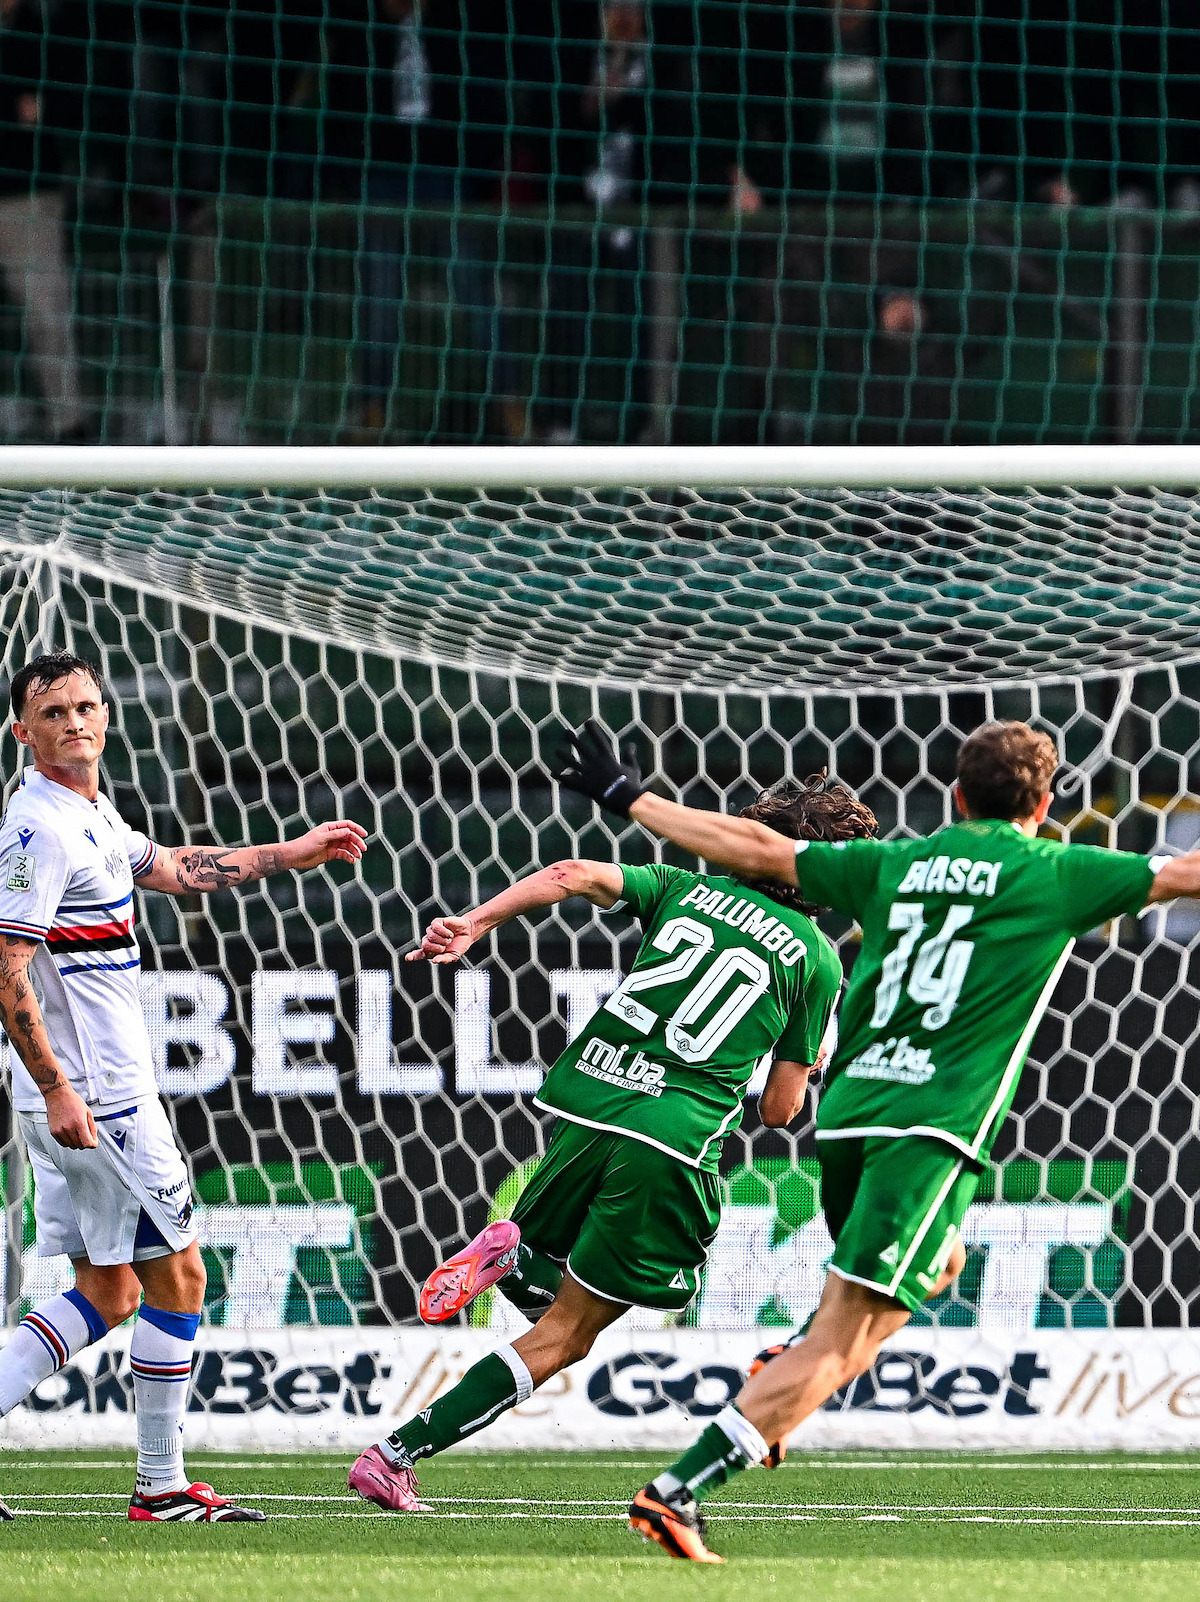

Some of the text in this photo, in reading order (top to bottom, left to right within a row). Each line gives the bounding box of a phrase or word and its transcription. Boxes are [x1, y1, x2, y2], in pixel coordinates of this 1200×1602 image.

[897, 856, 1002, 897] BIASCI
[678, 882, 807, 968] PALUMBO
[868, 902, 976, 1031] 14
[602, 916, 771, 1063] 20
[138, 969, 642, 1097] BELLT
[577, 1061, 607, 1082] PORTE
[615, 1078, 661, 1097] FINESTRE
[587, 1349, 1050, 1418] GoBet
